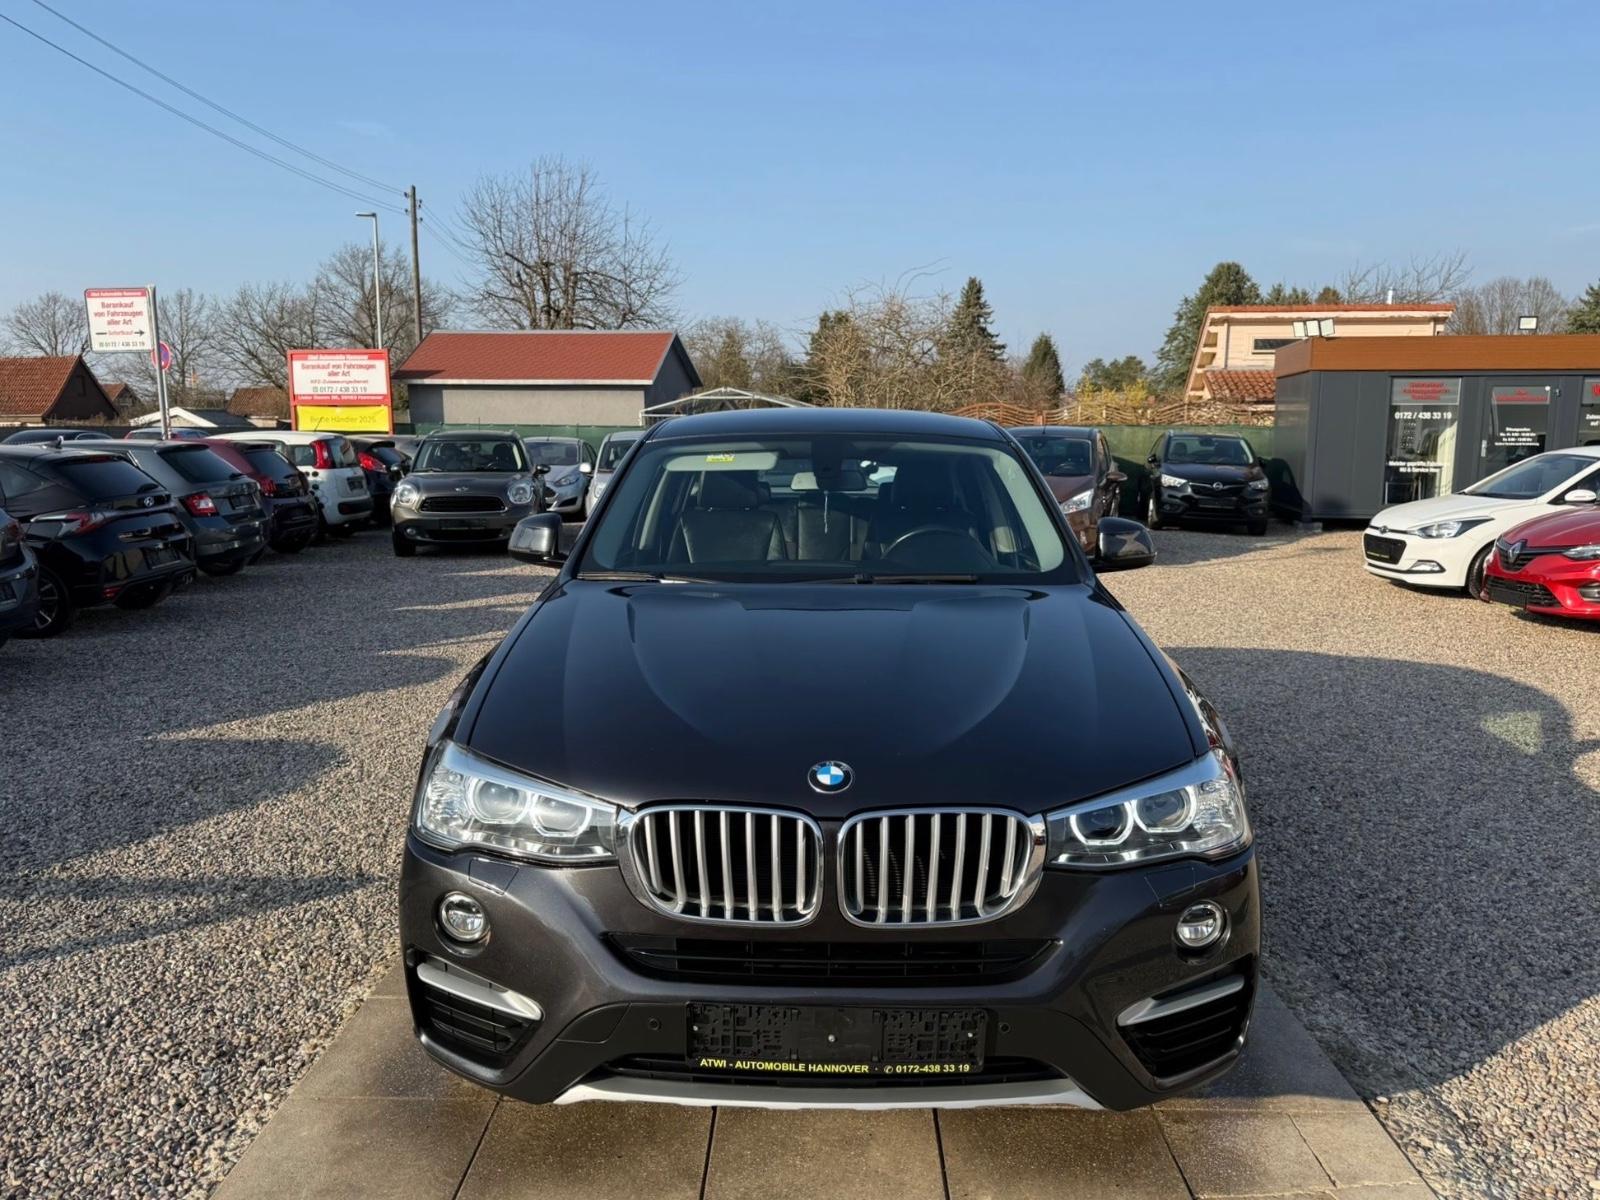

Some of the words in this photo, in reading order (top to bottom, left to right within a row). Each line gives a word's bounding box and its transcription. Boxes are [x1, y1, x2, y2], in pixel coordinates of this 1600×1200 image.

[107, 310, 144, 318] Fahrzeugen
[343, 363, 377, 371] Fahrzeugen
[1394, 411, 1413, 420] 0172
[1418, 411, 1431, 420] 438
[1432, 411, 1442, 420] 33
[1443, 411, 1453, 420] 19
[700, 1058, 727, 1068] ATWI
[735, 1060, 806, 1072] AUTOMOBILE
[808, 1063, 869, 1073] HANNOVER
[895, 1064, 941, 1073] 0172-438
[943, 1064, 955, 1072] 33
[958, 1064, 970, 1072] 19
